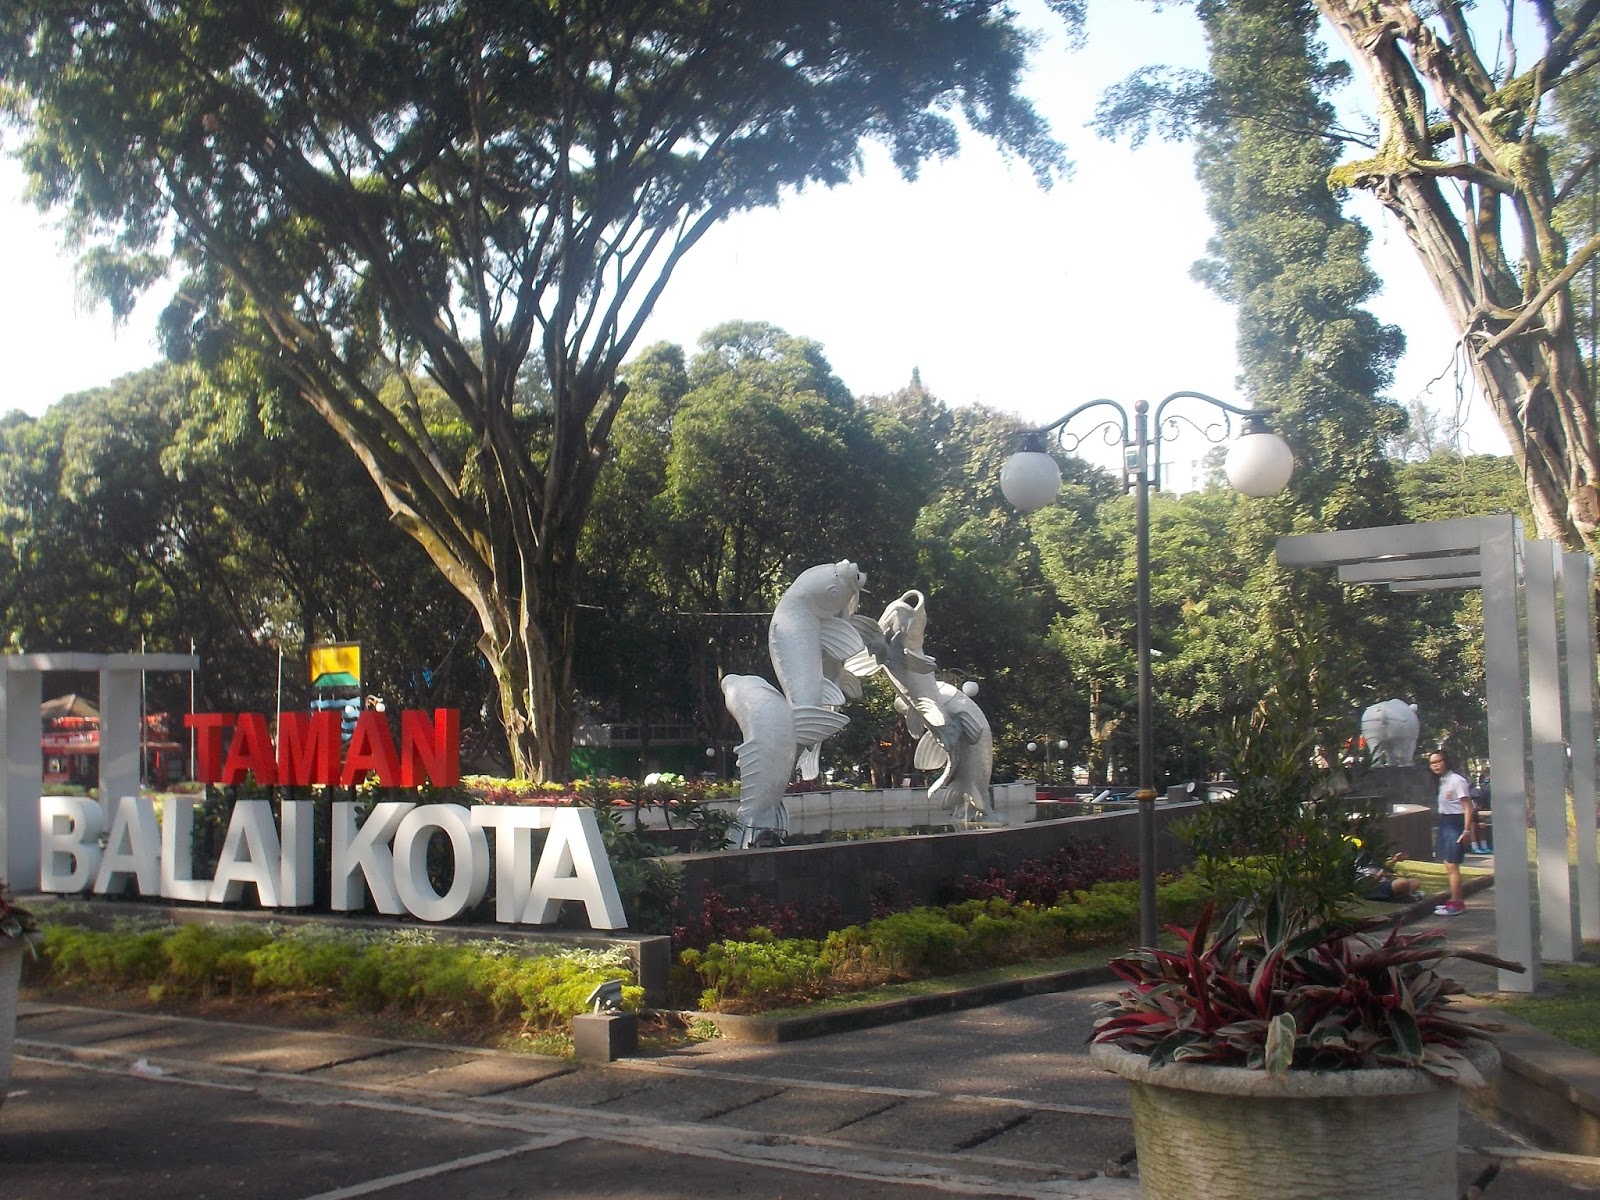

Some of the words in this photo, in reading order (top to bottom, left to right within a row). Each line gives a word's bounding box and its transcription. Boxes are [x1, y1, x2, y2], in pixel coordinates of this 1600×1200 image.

[184, 708, 460, 788] TAMAN
[40, 796, 314, 907] BALAI
[331, 801, 628, 930] KOTA
